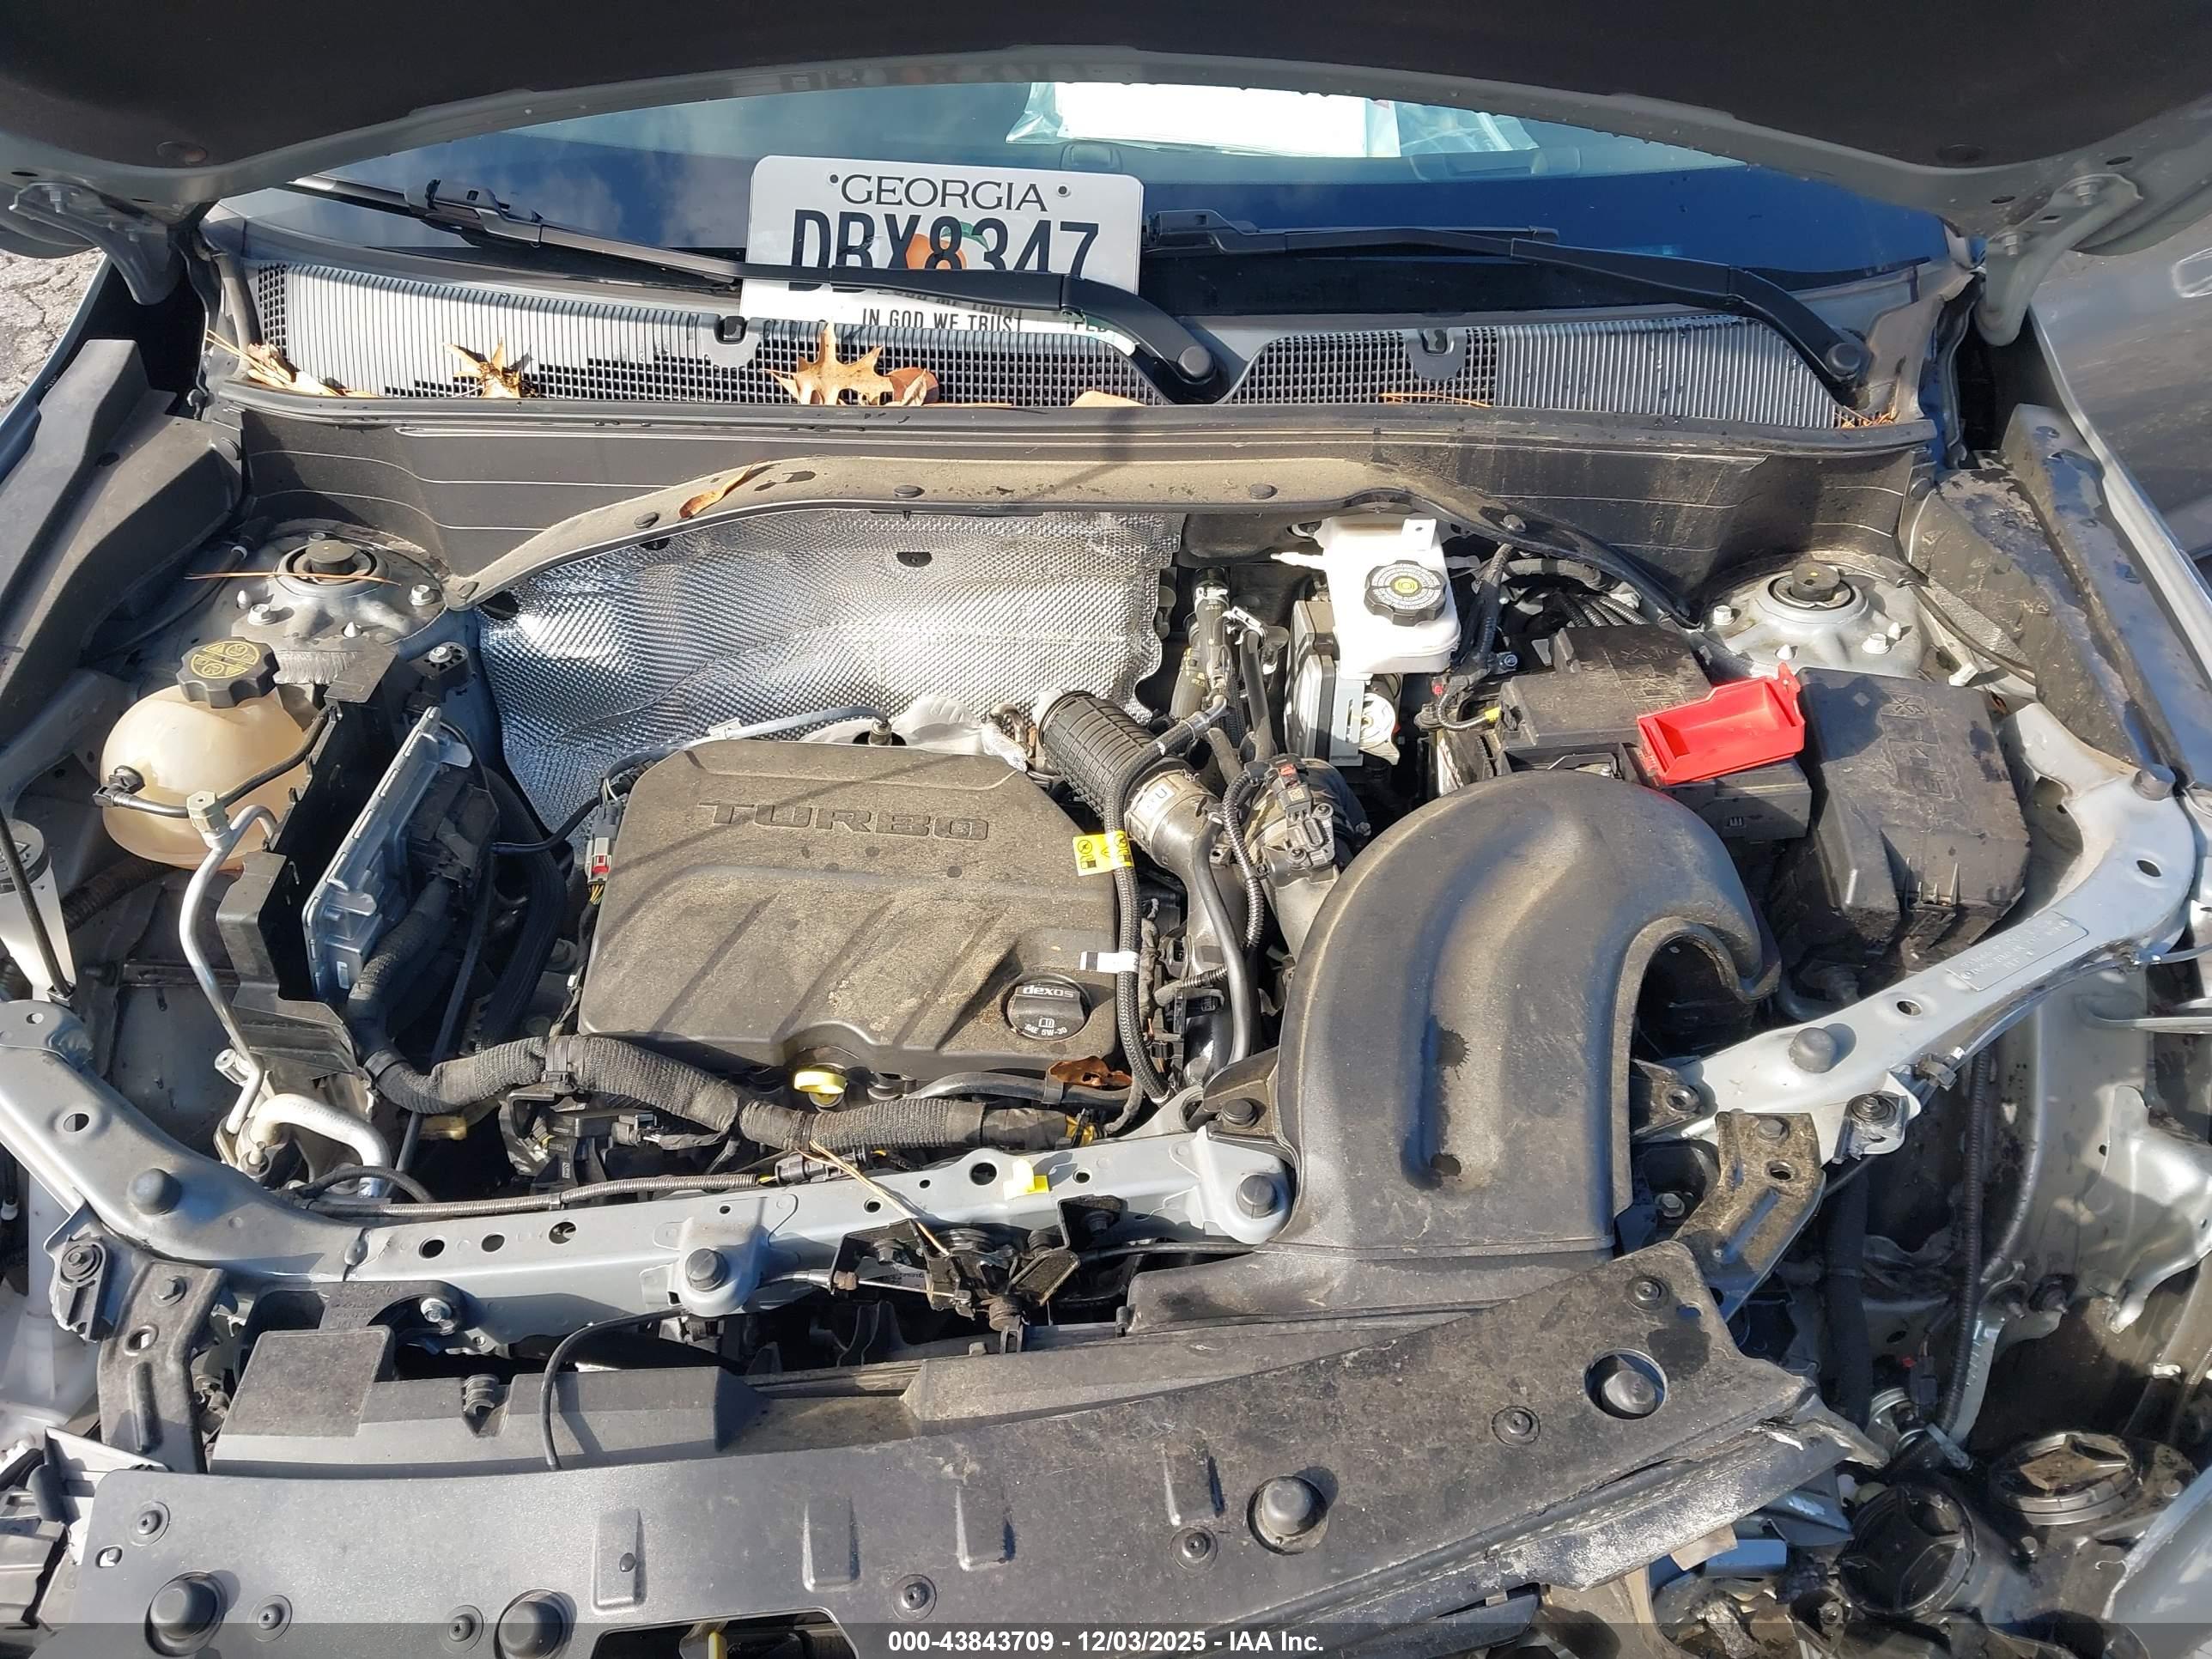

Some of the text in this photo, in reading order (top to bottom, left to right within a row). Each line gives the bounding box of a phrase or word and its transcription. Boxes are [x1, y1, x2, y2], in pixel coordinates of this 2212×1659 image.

[841, 173, 1048, 212] GEORGIA
[788, 209, 1100, 293] DBX8347
[862, 308, 1024, 333] IN GOD WE TRUST
[696, 802, 989, 842] TURBO
[1023, 985, 1074, 998] dexos
[1024, 1024, 1067, 1036] SAE 5W-30
